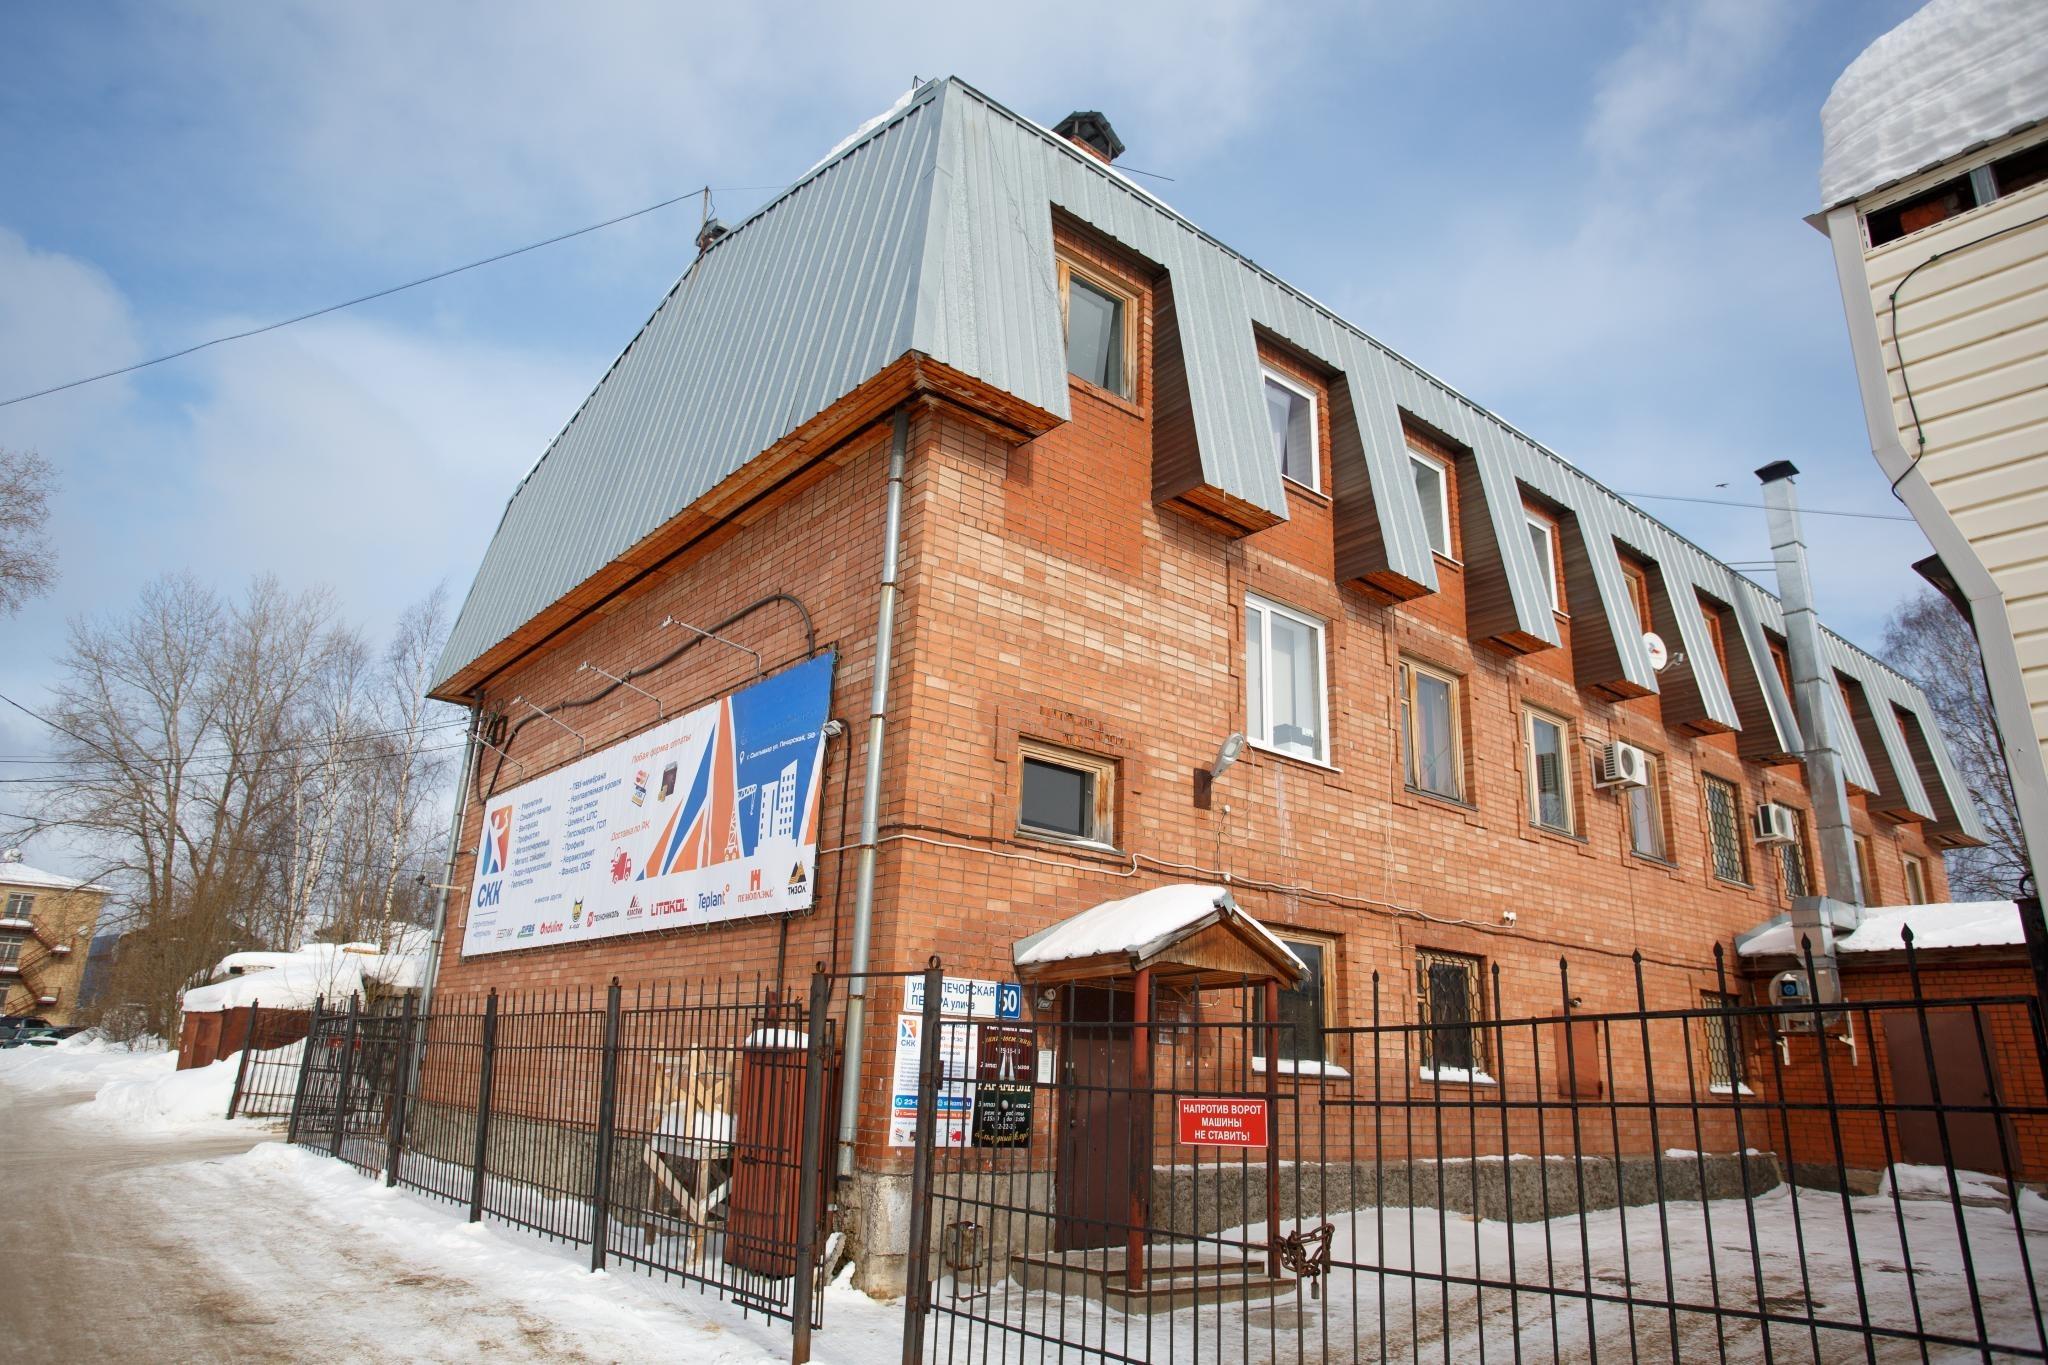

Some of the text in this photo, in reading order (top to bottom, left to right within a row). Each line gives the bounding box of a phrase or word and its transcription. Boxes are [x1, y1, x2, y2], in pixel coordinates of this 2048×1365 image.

[632, 733, 692, 764] Любая форма оплаты
[478, 880, 502, 907] СКК
[737, 890, 774, 903] ПЕНОПЛЭКС
[788, 886, 806, 896] ТИЗОЛ
[651, 898, 687, 917] LITOKOL
[699, 890, 726, 912] Teplant
[999, 990, 1018, 1012] 50
[901, 1039, 916, 1047] СКК
[1183, 1104, 1262, 1115] НАПРОТИВ ВОРОТ
[1201, 1117, 1242, 1128] МАШИНЫ
[1194, 1130, 1250, 1141] НЕ СТАВИТЬ!
